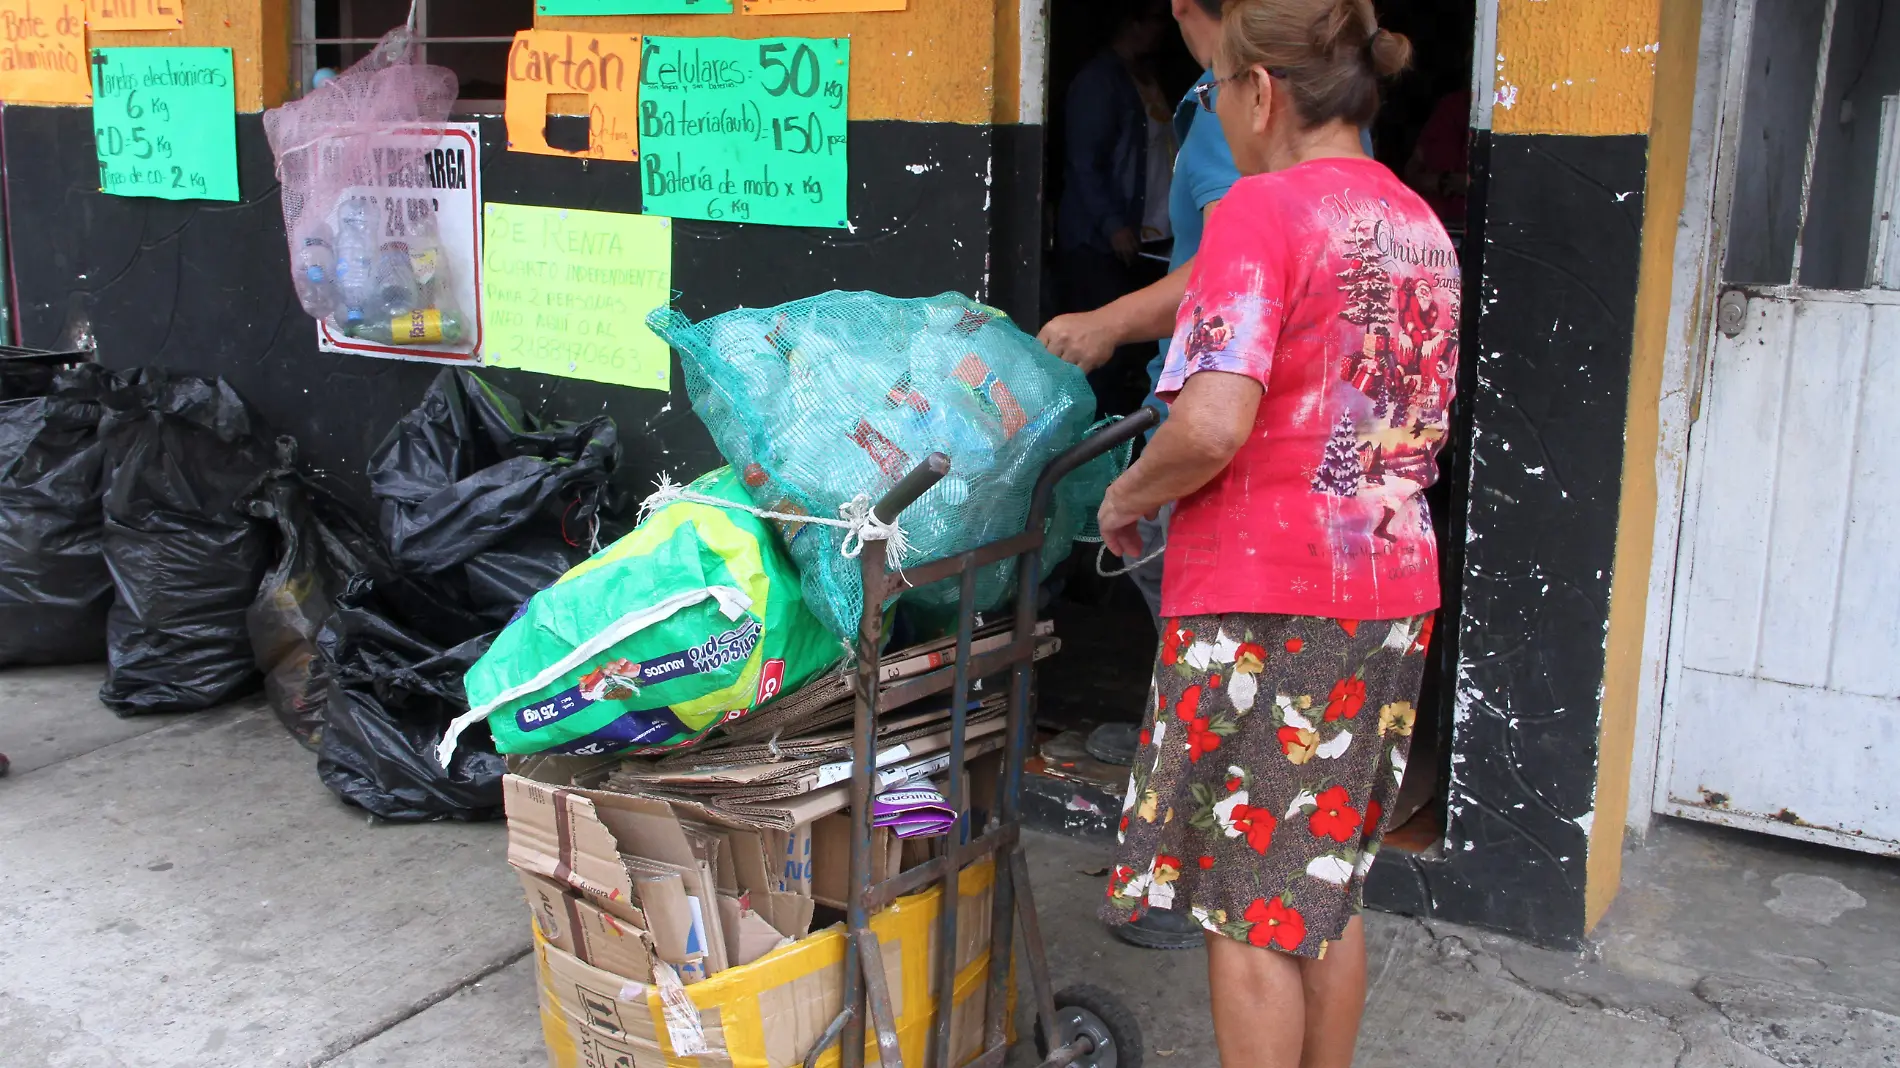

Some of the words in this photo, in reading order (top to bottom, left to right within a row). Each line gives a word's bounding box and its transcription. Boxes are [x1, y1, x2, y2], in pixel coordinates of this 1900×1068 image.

[56, 4, 80, 38] de
[509, 34, 624, 92] Cartón
[759, 42, 820, 98] 50
[127, 89, 144, 119] 6
[772, 112, 823, 154] 150
[171, 165, 187, 188] 2
[718, 169, 736, 195] de
[744, 164, 779, 198] moto
[707, 197, 724, 220] 6
[528, 288, 541, 307] 2
[490, 309, 523, 327] INFO
[689, 635, 717, 662] pro
[644, 658, 685, 678] ADULTOS
[523, 709, 543, 723] kg
[540, 703, 559, 721] 25
